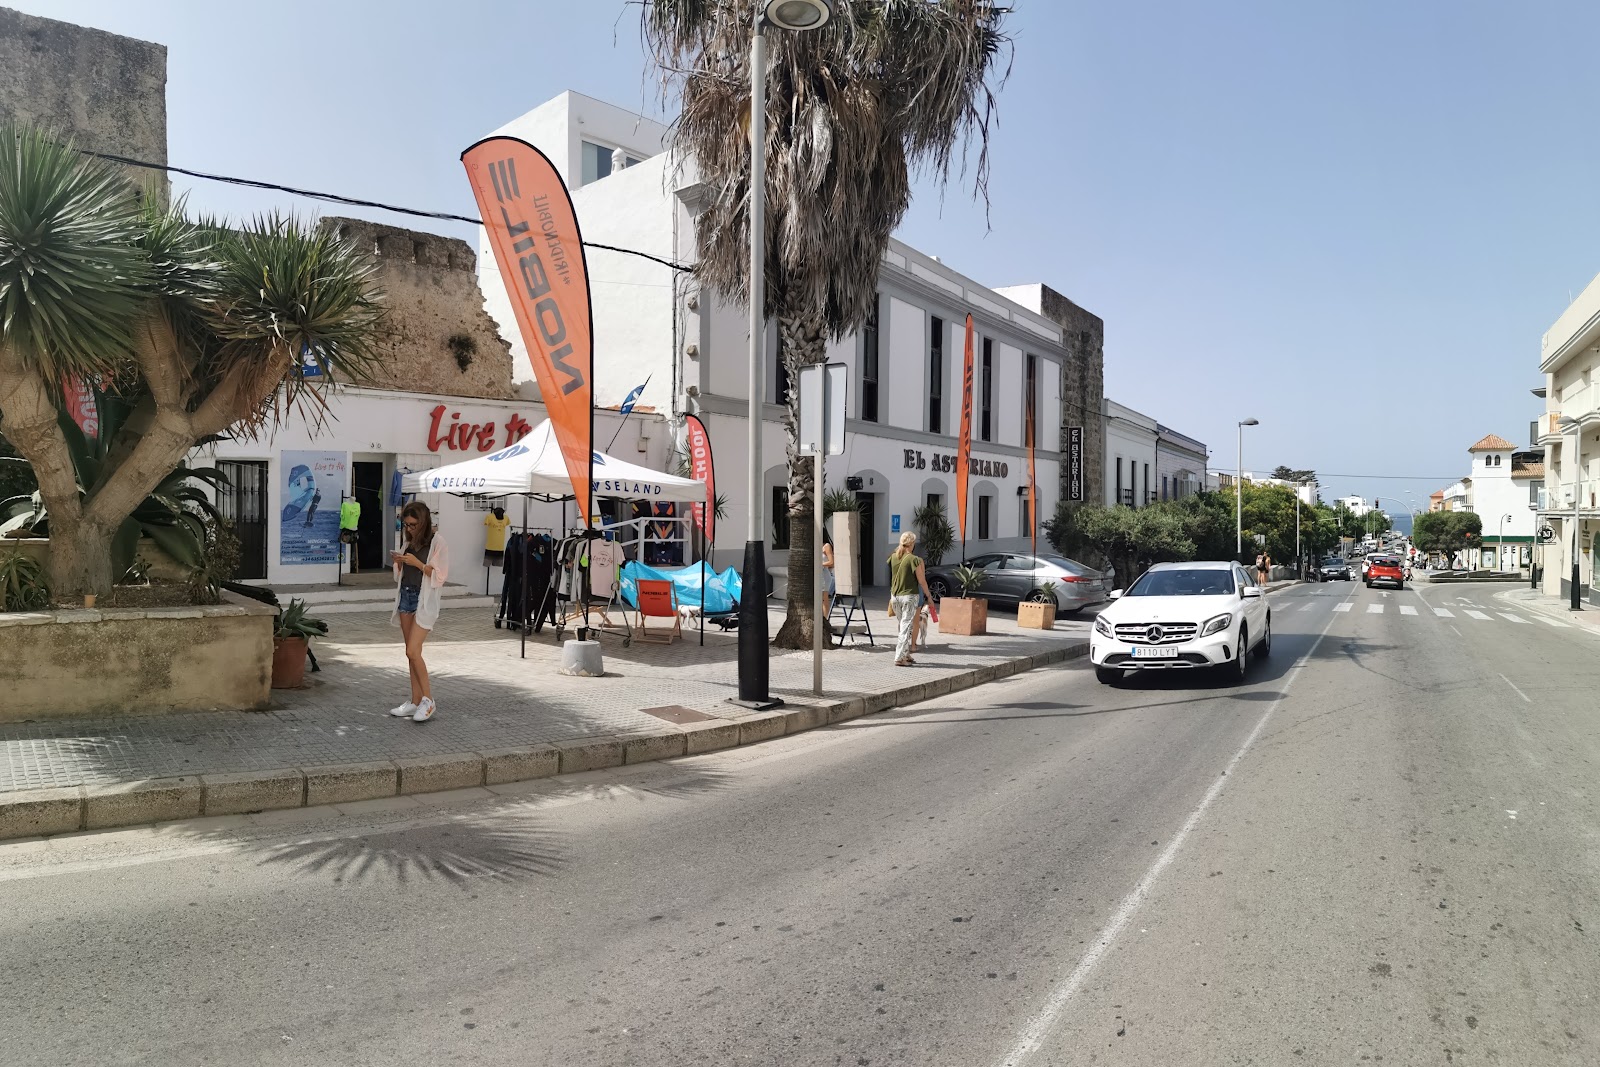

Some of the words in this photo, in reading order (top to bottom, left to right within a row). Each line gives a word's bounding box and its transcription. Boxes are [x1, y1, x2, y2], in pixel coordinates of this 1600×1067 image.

[427, 405, 496, 452] Live
[1071, 429, 1079, 442] EL
[903, 448, 926, 470] EL
[931, 453, 1009, 479] ASTRIANO
[1071, 444, 1079, 499] ASTURIANO
[442, 477, 486, 488] SELAND
[605, 480, 662, 495] SELAND
